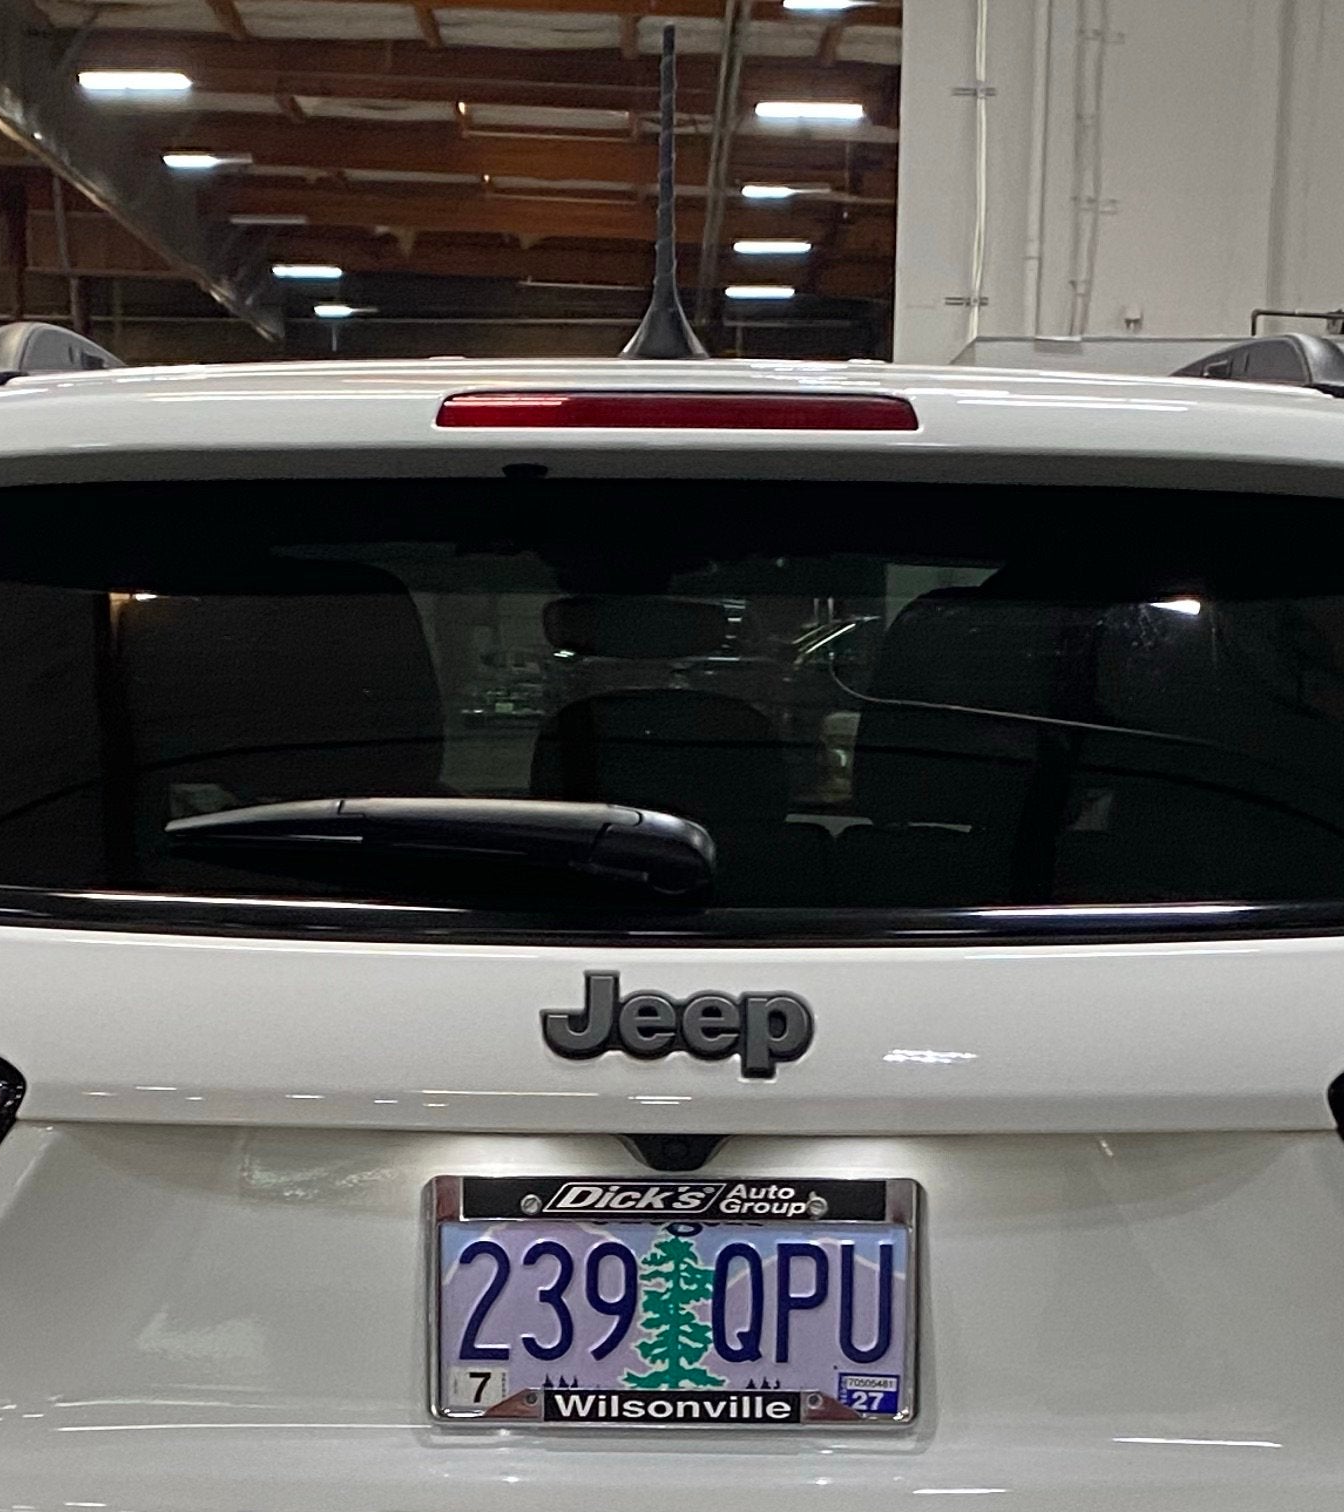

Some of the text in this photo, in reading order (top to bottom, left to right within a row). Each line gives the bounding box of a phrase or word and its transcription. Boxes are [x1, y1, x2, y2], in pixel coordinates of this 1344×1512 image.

[539, 970, 814, 1079] Jeep
[726, 1184, 795, 1200] Auto
[719, 1199, 807, 1217] Group
[458, 1241, 894, 1364] 239 QPU
[468, 1371, 492, 1403] 7
[554, 1393, 792, 1419] Wilsonville
[851, 1390, 885, 1411] 27
